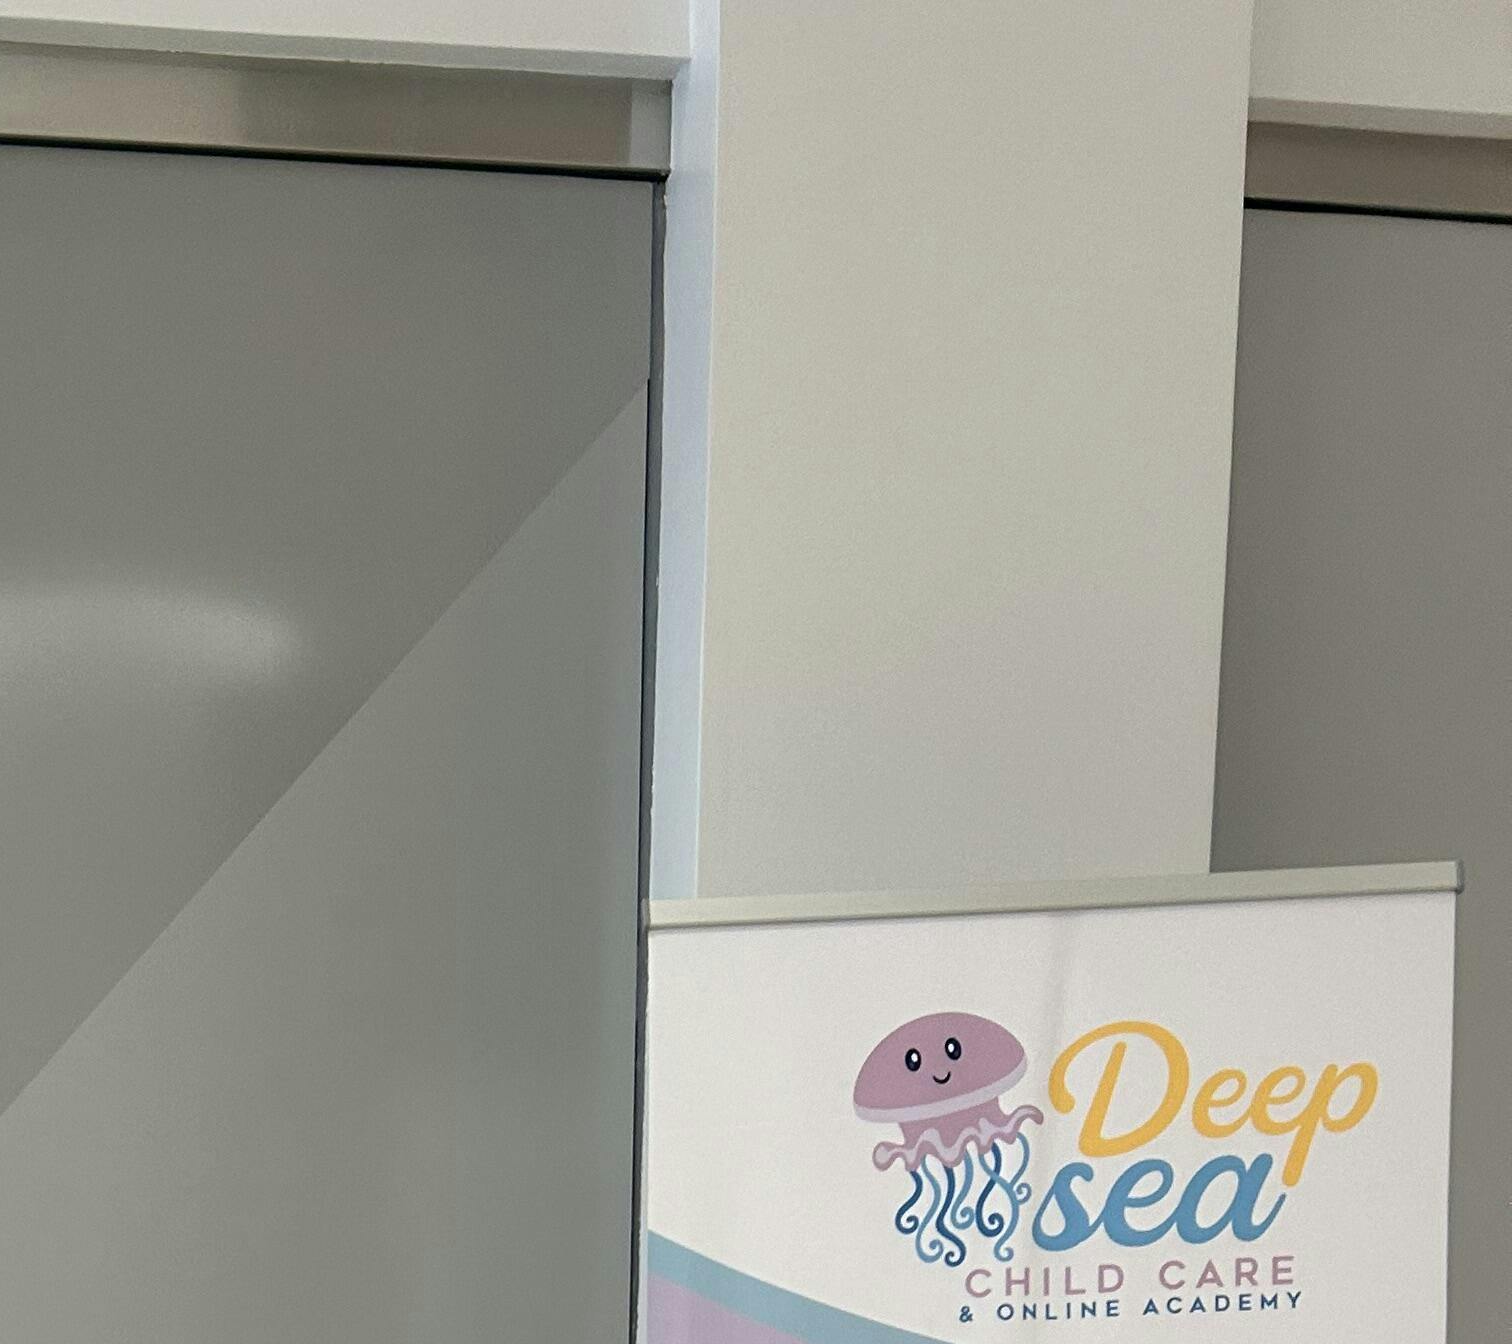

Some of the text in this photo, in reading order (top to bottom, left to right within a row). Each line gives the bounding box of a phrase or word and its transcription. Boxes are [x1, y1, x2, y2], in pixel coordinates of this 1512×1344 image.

[1048, 1020, 1378, 1186] Deep
[1031, 1152, 1286, 1252] sea
[959, 1292, 1301, 1322] & ONLINE ACADEMY
[965, 1256, 1296, 1298] CHILD CARE
